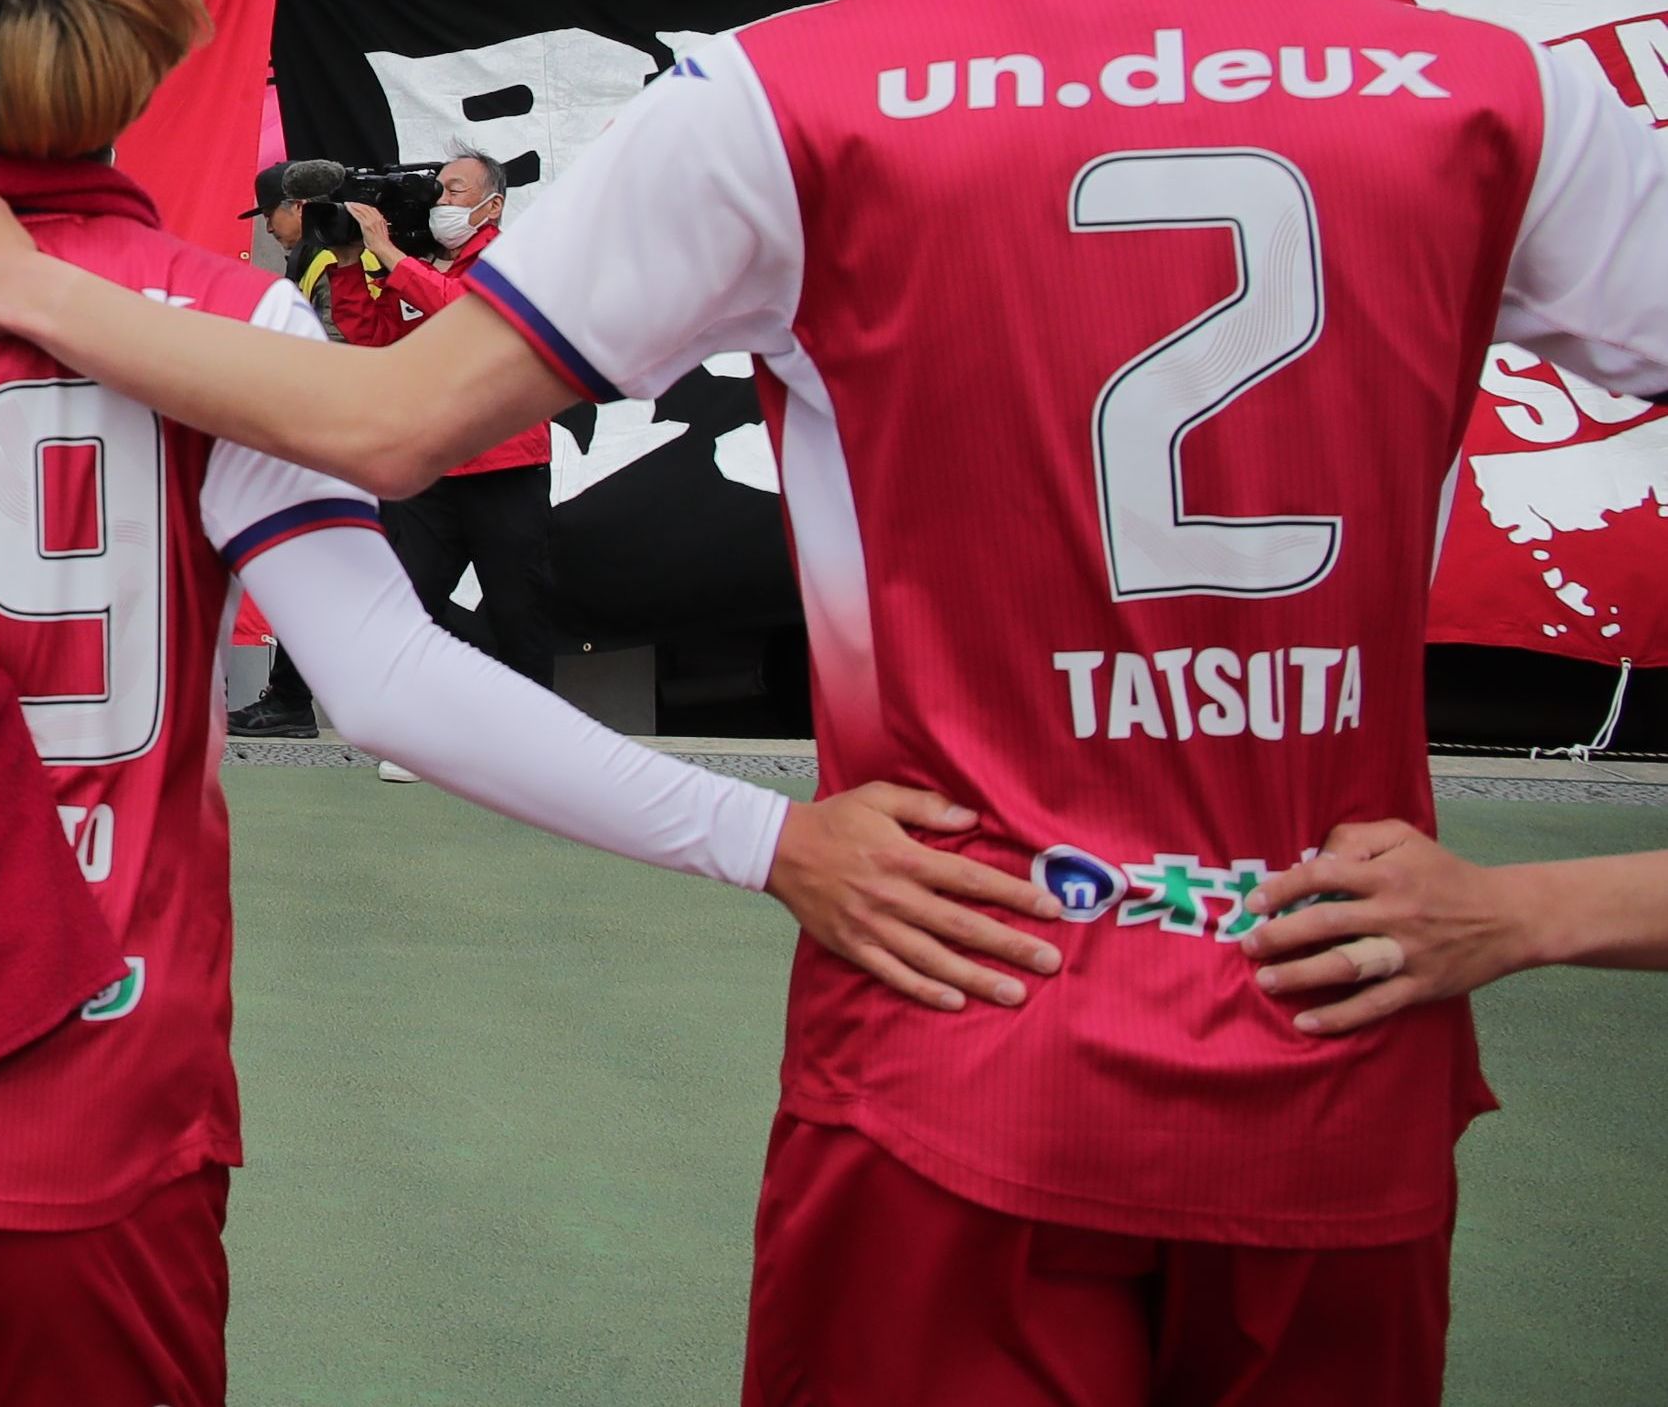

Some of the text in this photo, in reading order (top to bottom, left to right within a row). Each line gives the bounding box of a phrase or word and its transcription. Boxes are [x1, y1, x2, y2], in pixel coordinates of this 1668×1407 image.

[877, 28, 1451, 120] un.deux
[1068, 145, 1343, 603] 2
[1053, 644, 1363, 742] TATSUTA
